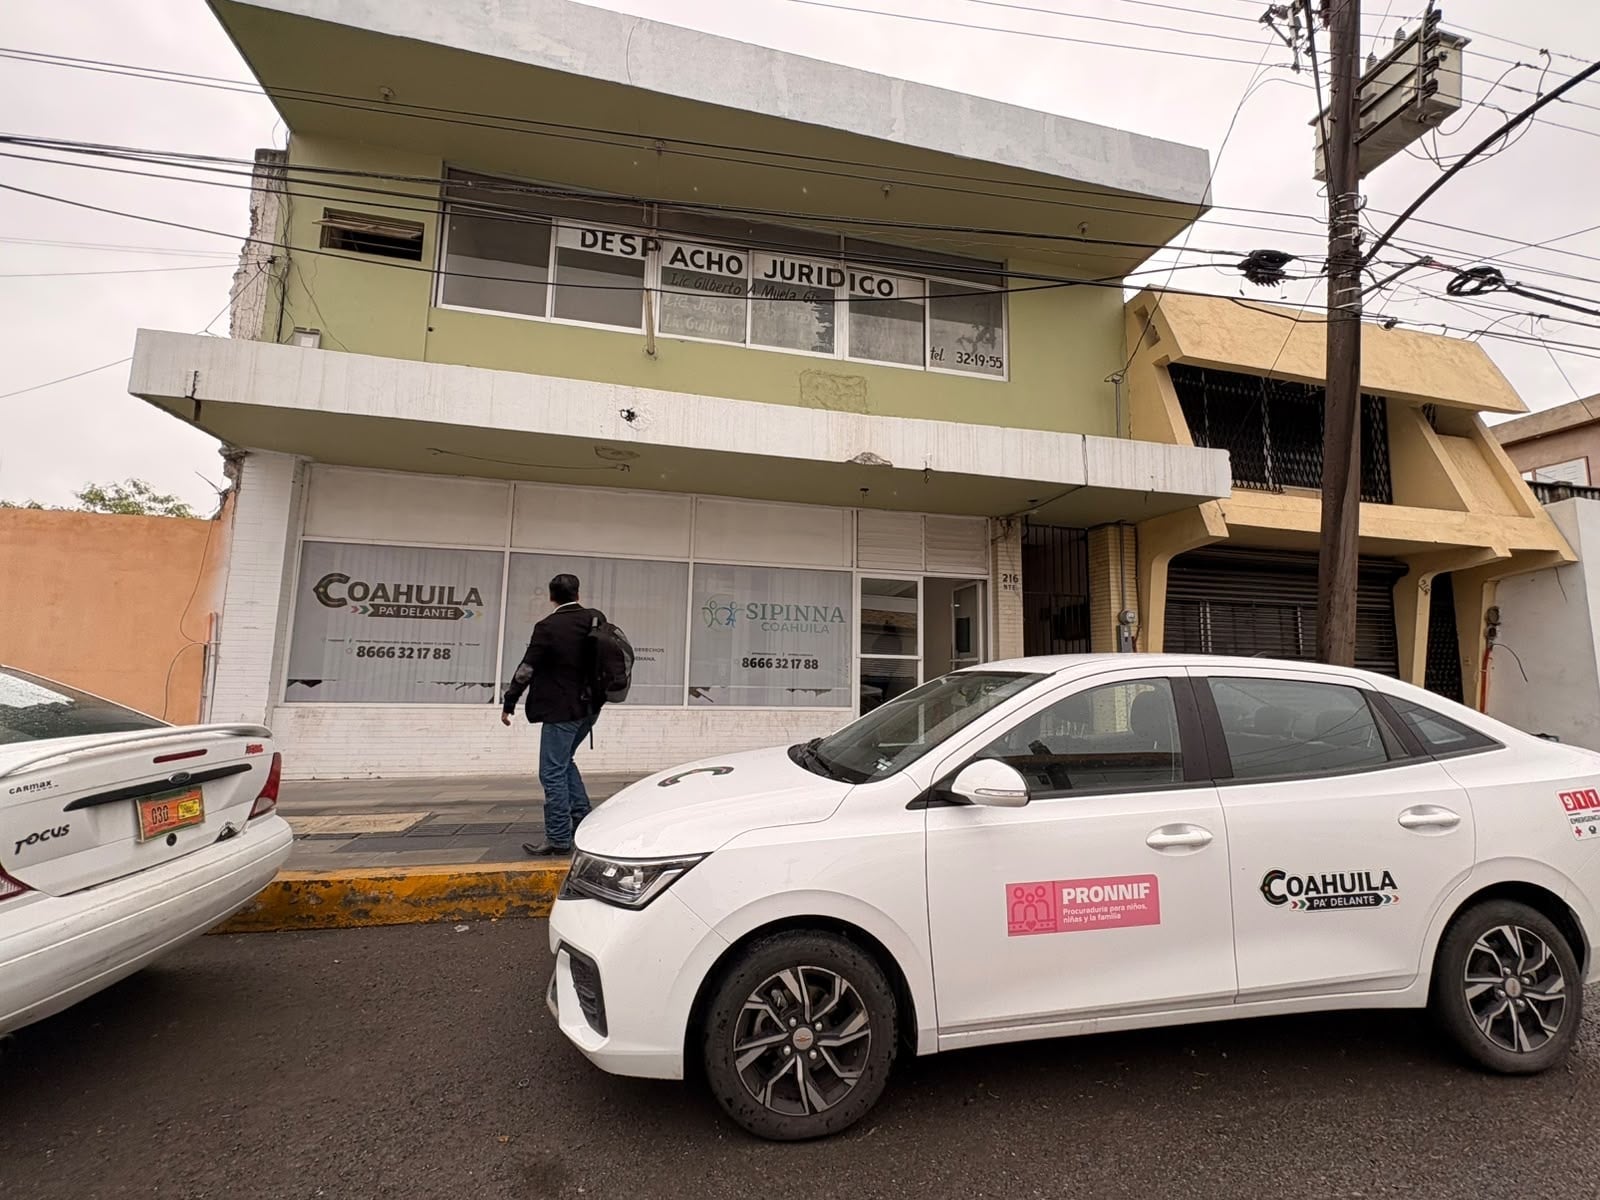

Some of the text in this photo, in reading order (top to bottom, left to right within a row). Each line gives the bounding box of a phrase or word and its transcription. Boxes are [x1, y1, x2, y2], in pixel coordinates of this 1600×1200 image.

[763, 259, 894, 297] JURIDICO
[694, 277, 742, 295] Gilberto
[761, 285, 797, 300] Muela
[1002, 573, 1019, 583] 216
[312, 572, 484, 609] COAHUILA
[400, 607, 455, 618] DELANTE
[746, 602, 846, 624] SIPINNA
[761, 622, 830, 634] COAHUILA
[1563, 791, 1598, 809] 911
[1061, 882, 1151, 905] PRONNIF
[1259, 869, 1399, 906] COAHUILA
[1109, 905, 1126, 915] para
[1330, 895, 1376, 907] DELANTE
[1063, 915, 1083, 924] niñas
[1097, 912, 1121, 921] familia
